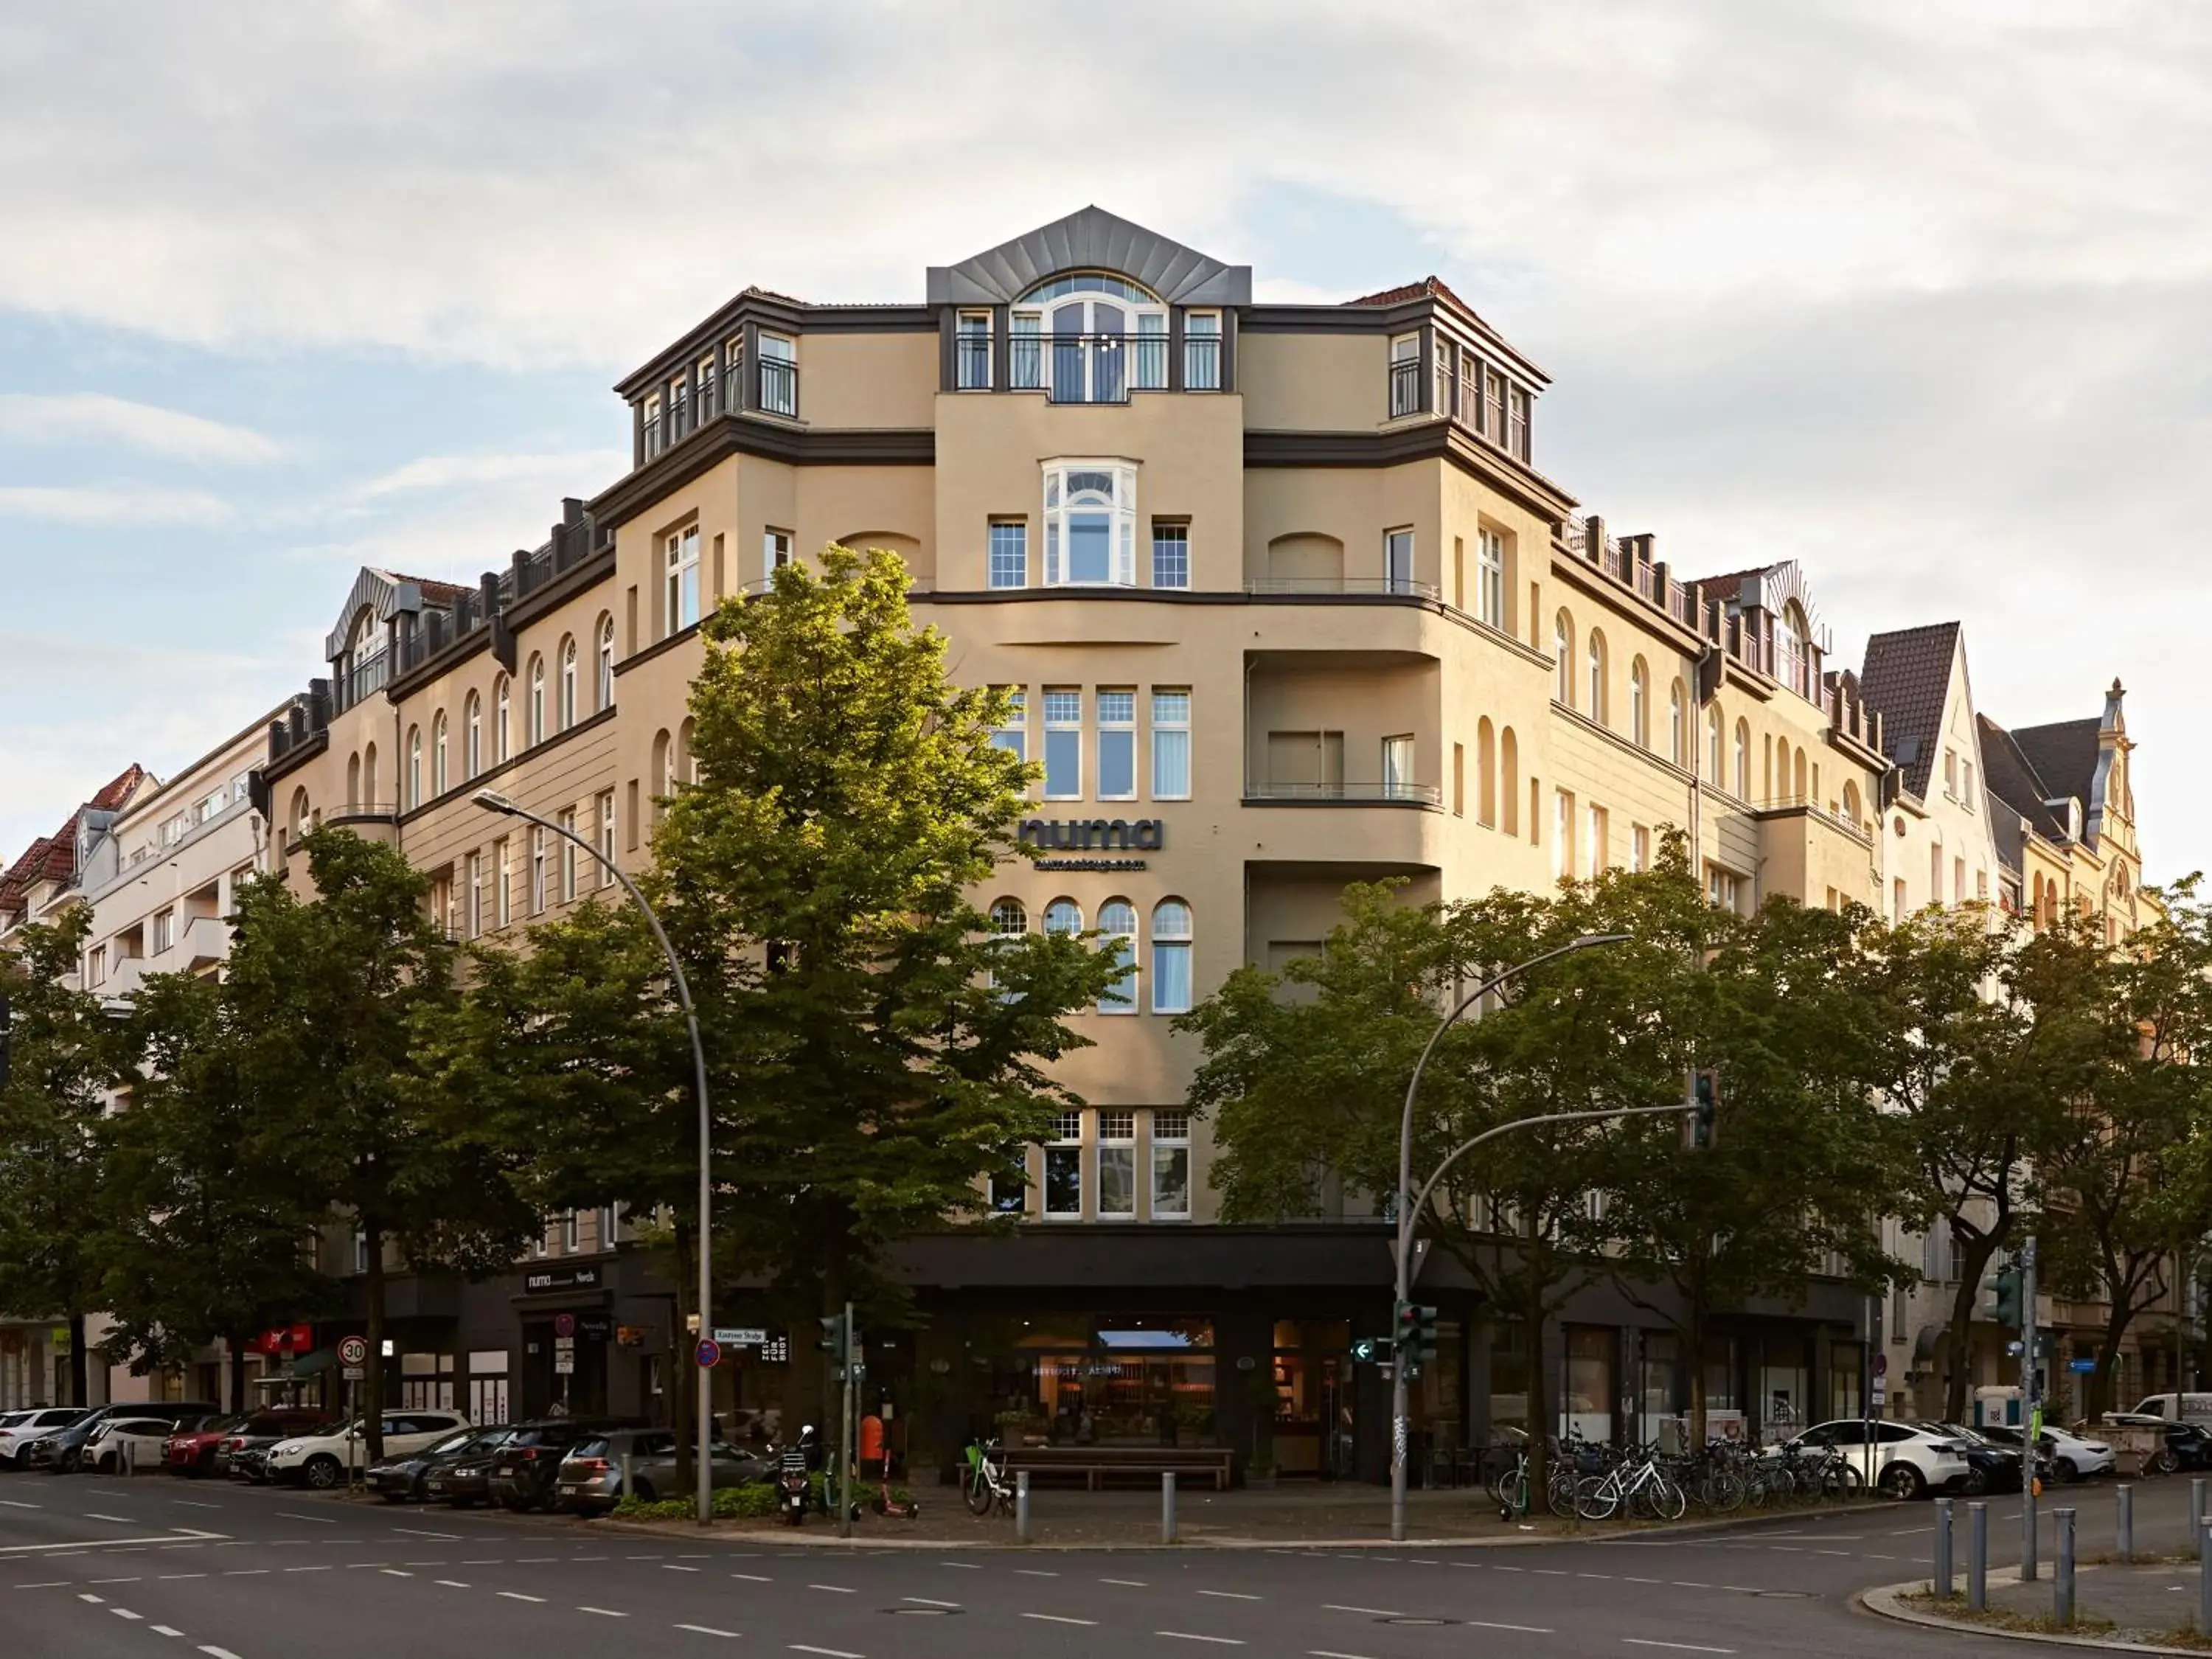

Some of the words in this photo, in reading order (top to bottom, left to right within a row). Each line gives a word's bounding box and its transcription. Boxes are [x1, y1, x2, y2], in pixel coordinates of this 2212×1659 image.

[1019, 819, 1162, 849] numa
[529, 1275, 552, 1287] numa
[345, 1344, 363, 1358] 30
[779, 1336, 787, 1362] BROT
